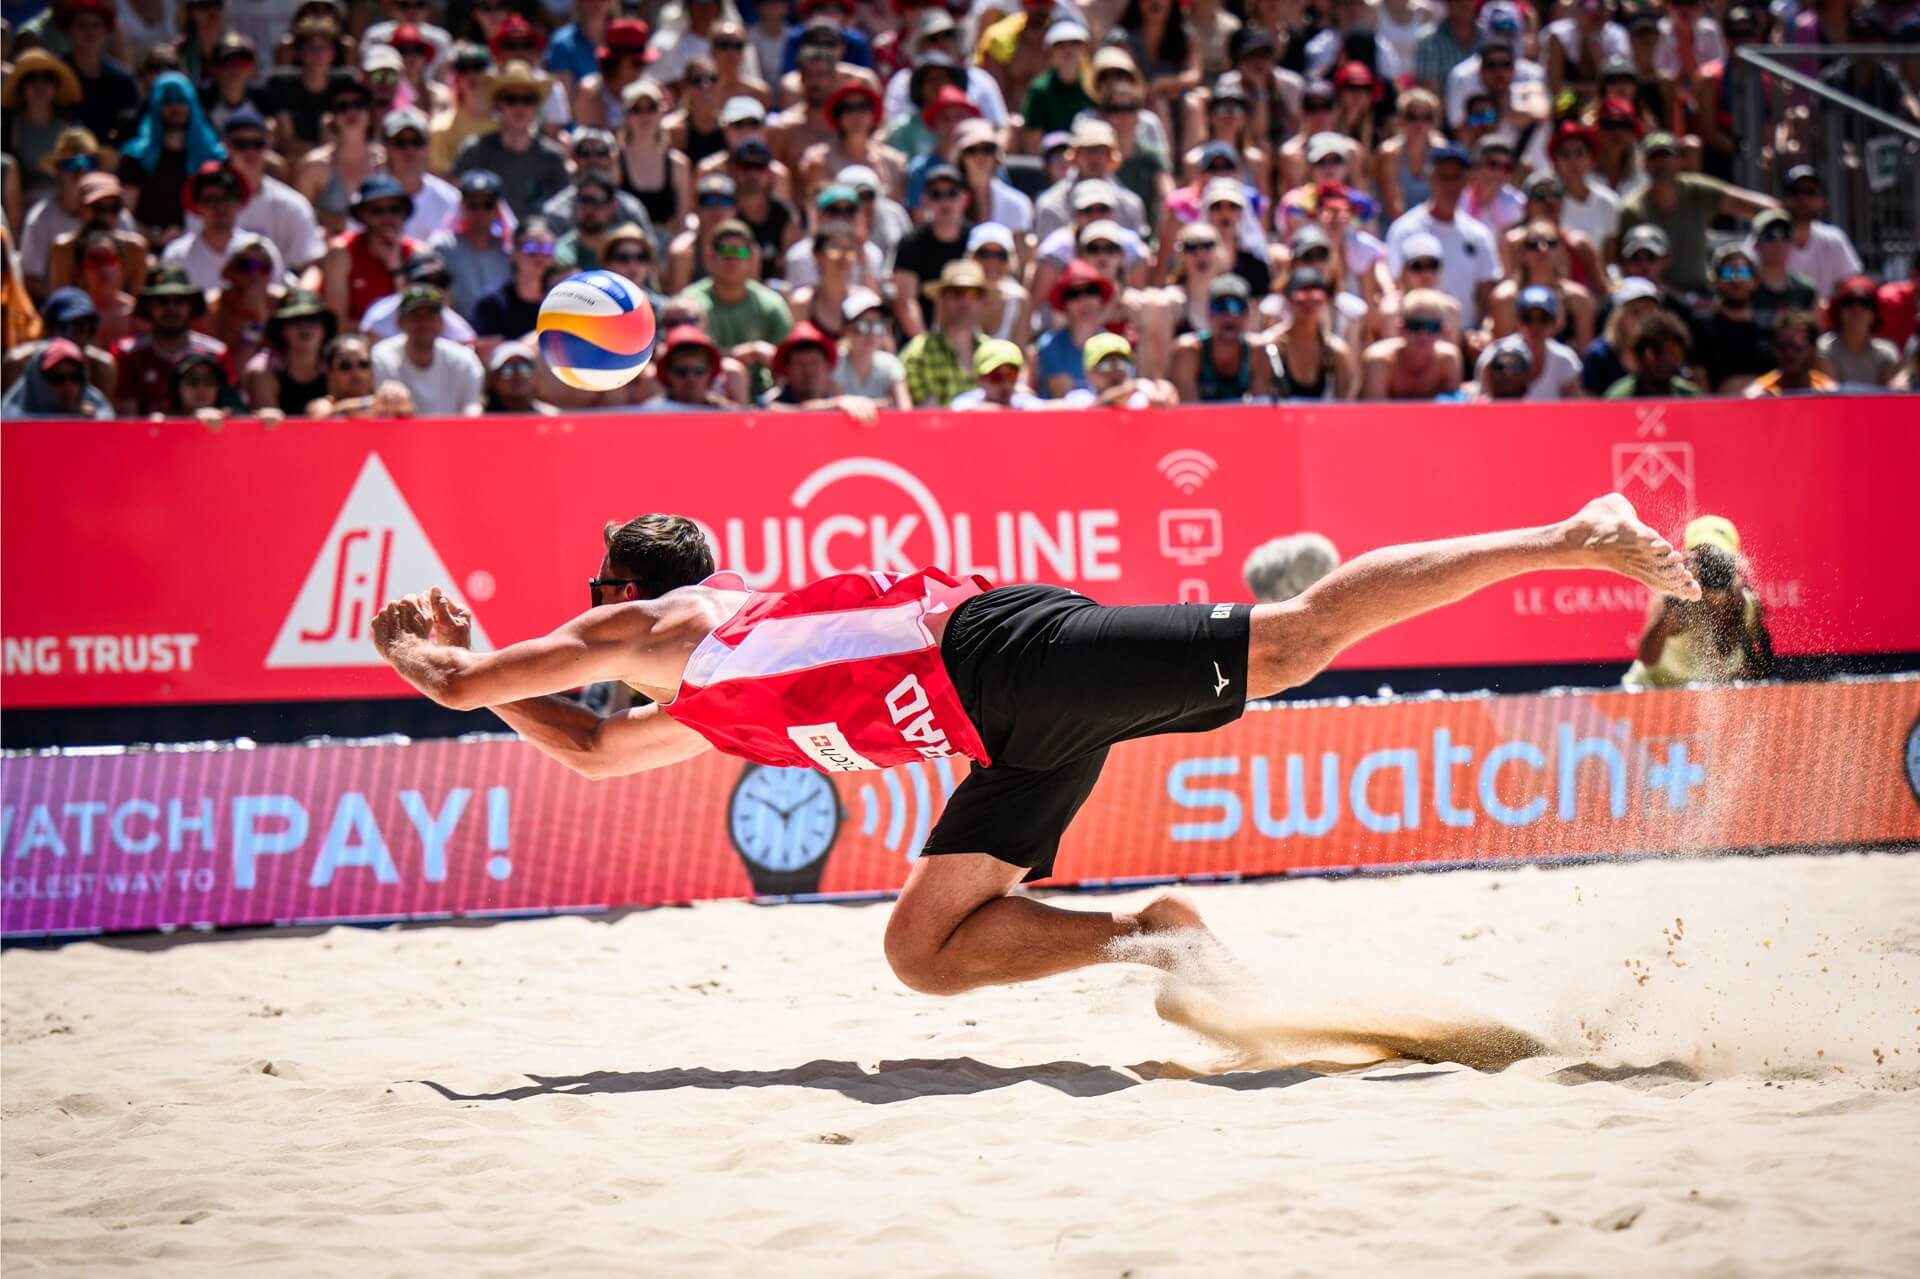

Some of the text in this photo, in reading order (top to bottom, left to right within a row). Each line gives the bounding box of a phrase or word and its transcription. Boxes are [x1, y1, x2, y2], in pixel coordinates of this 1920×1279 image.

[682, 509, 1122, 590] UICKLINE
[1513, 586, 1543, 614] LE
[1, 633, 199, 676] NG TRUST
[231, 786, 513, 891] PAY!
[105, 870, 168, 895] WAY
[176, 867, 216, 893] TO
